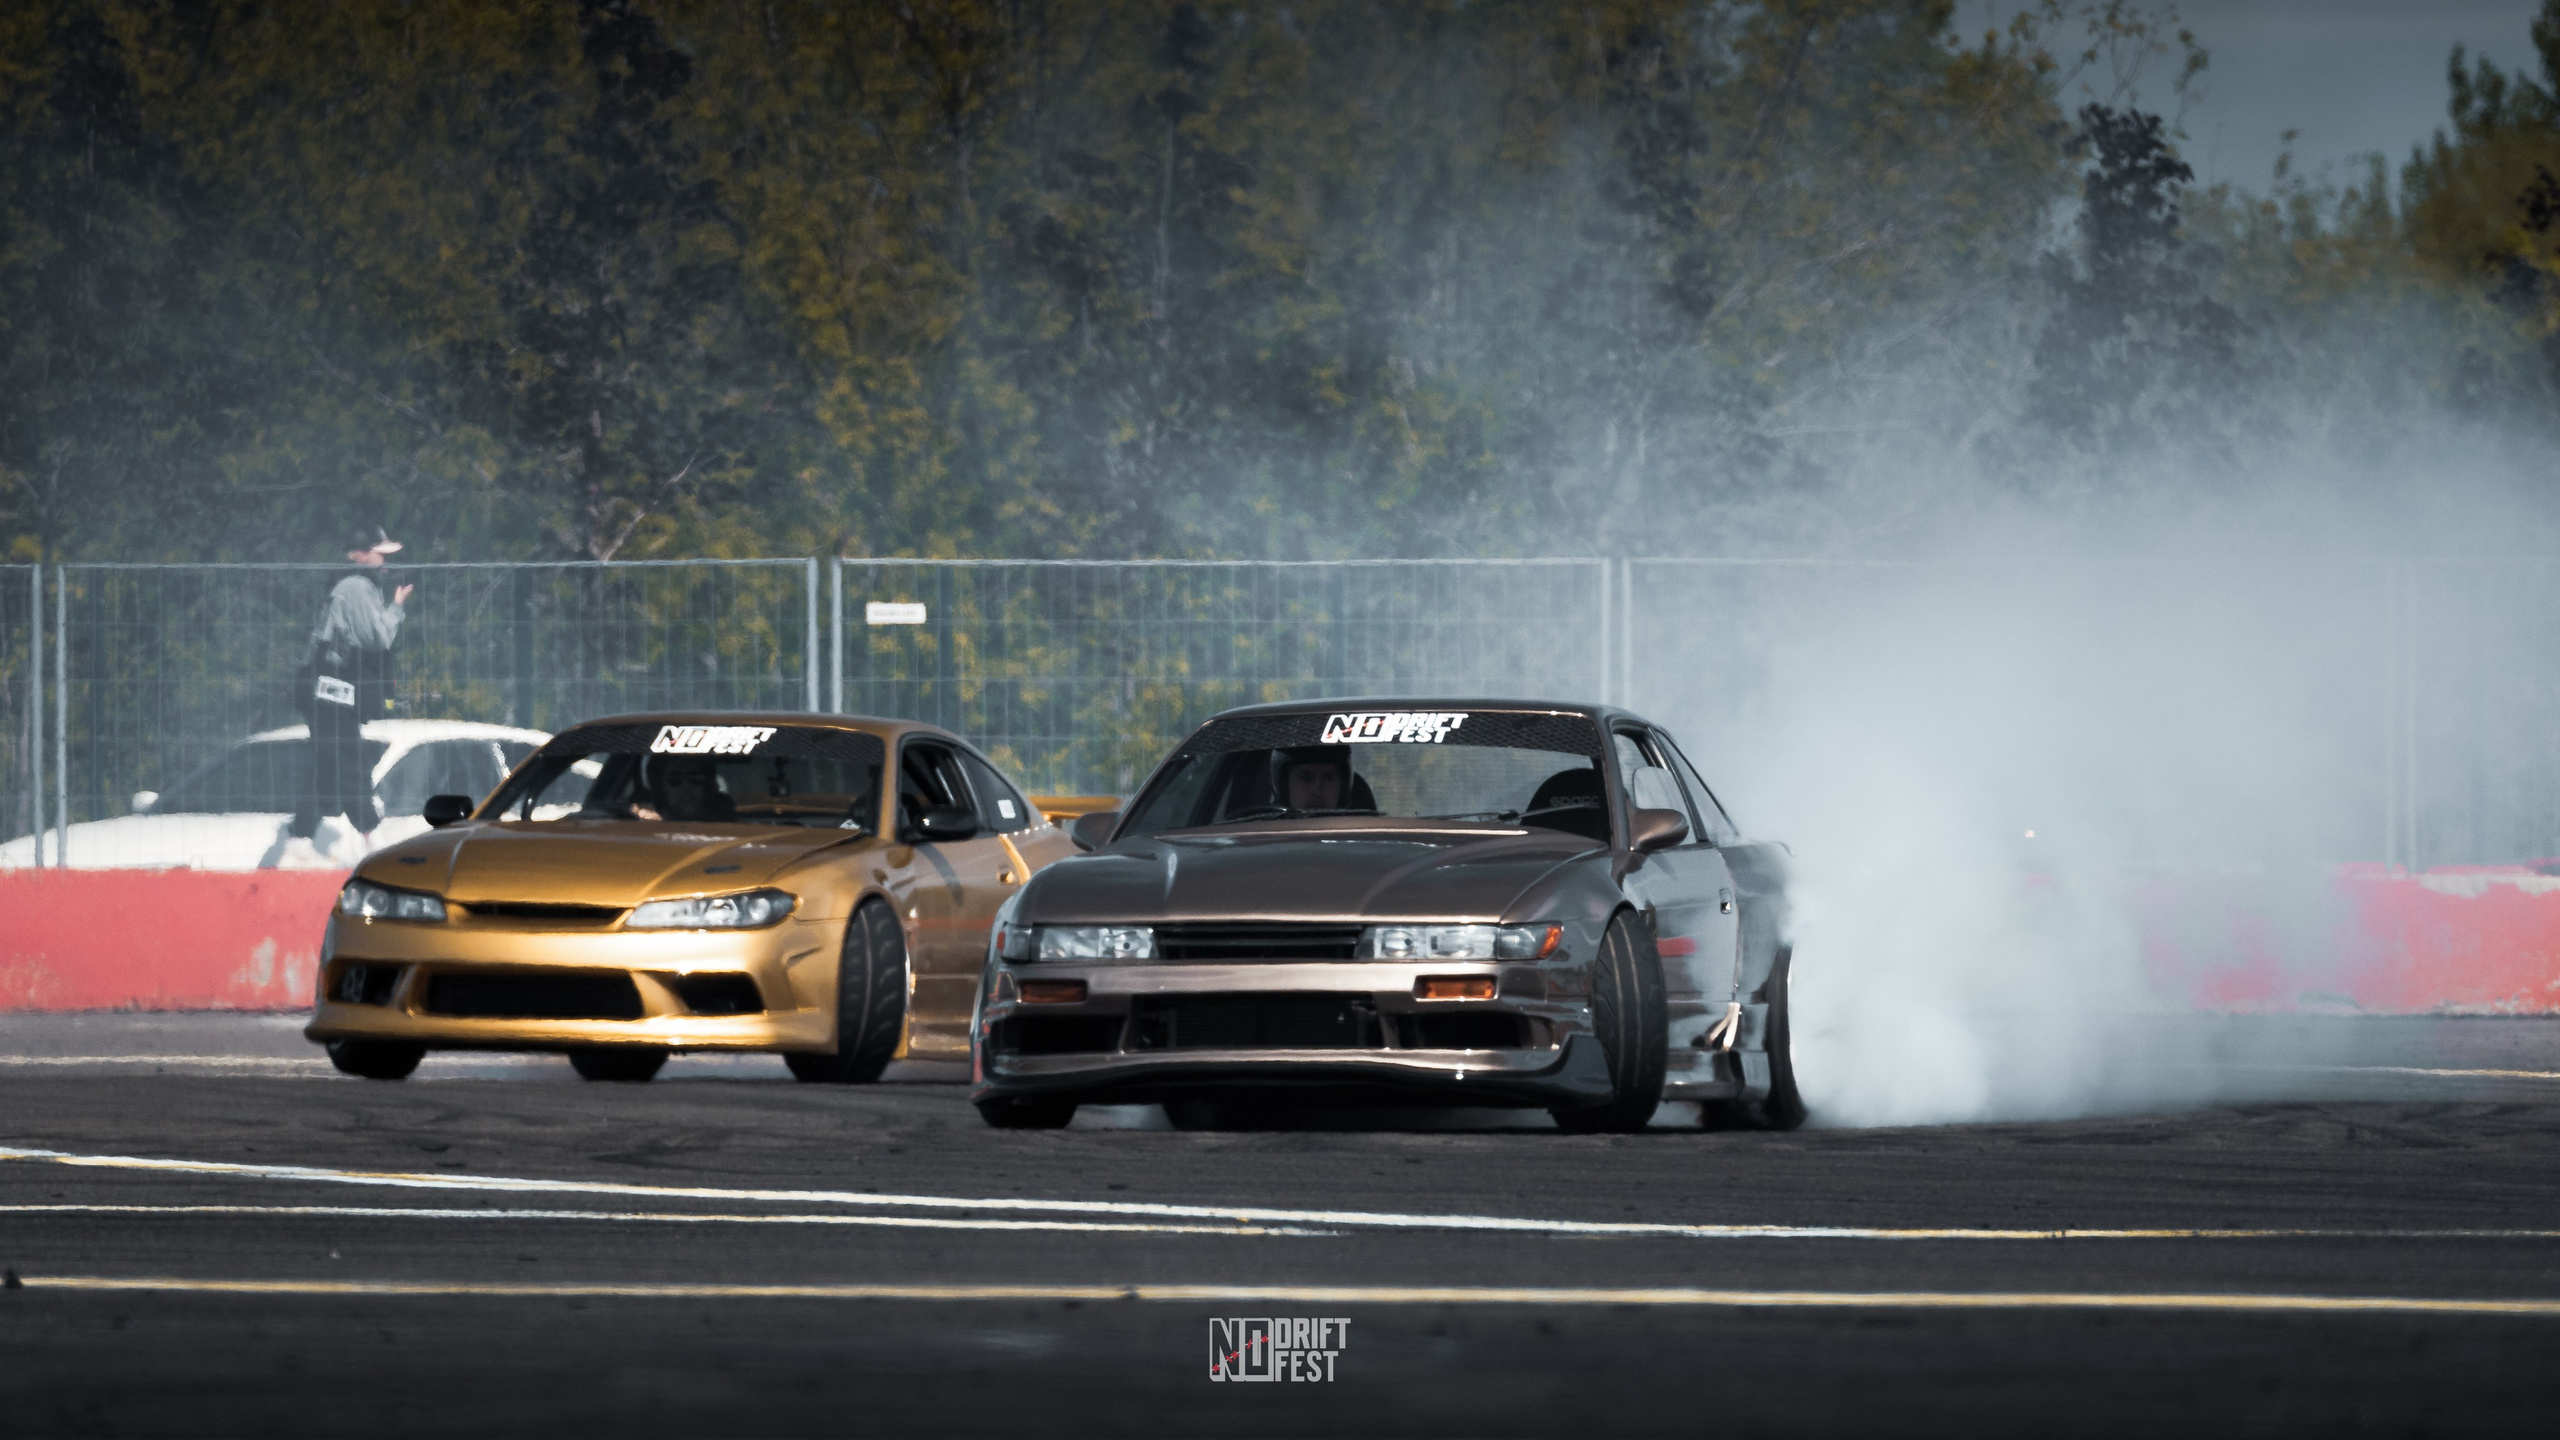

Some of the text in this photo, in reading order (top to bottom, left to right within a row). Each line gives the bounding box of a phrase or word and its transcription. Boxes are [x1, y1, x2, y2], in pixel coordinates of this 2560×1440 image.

[1391, 713, 1469, 728] DRIFT
[1385, 727, 1451, 743] FEST
[706, 739, 760, 754] FEST
